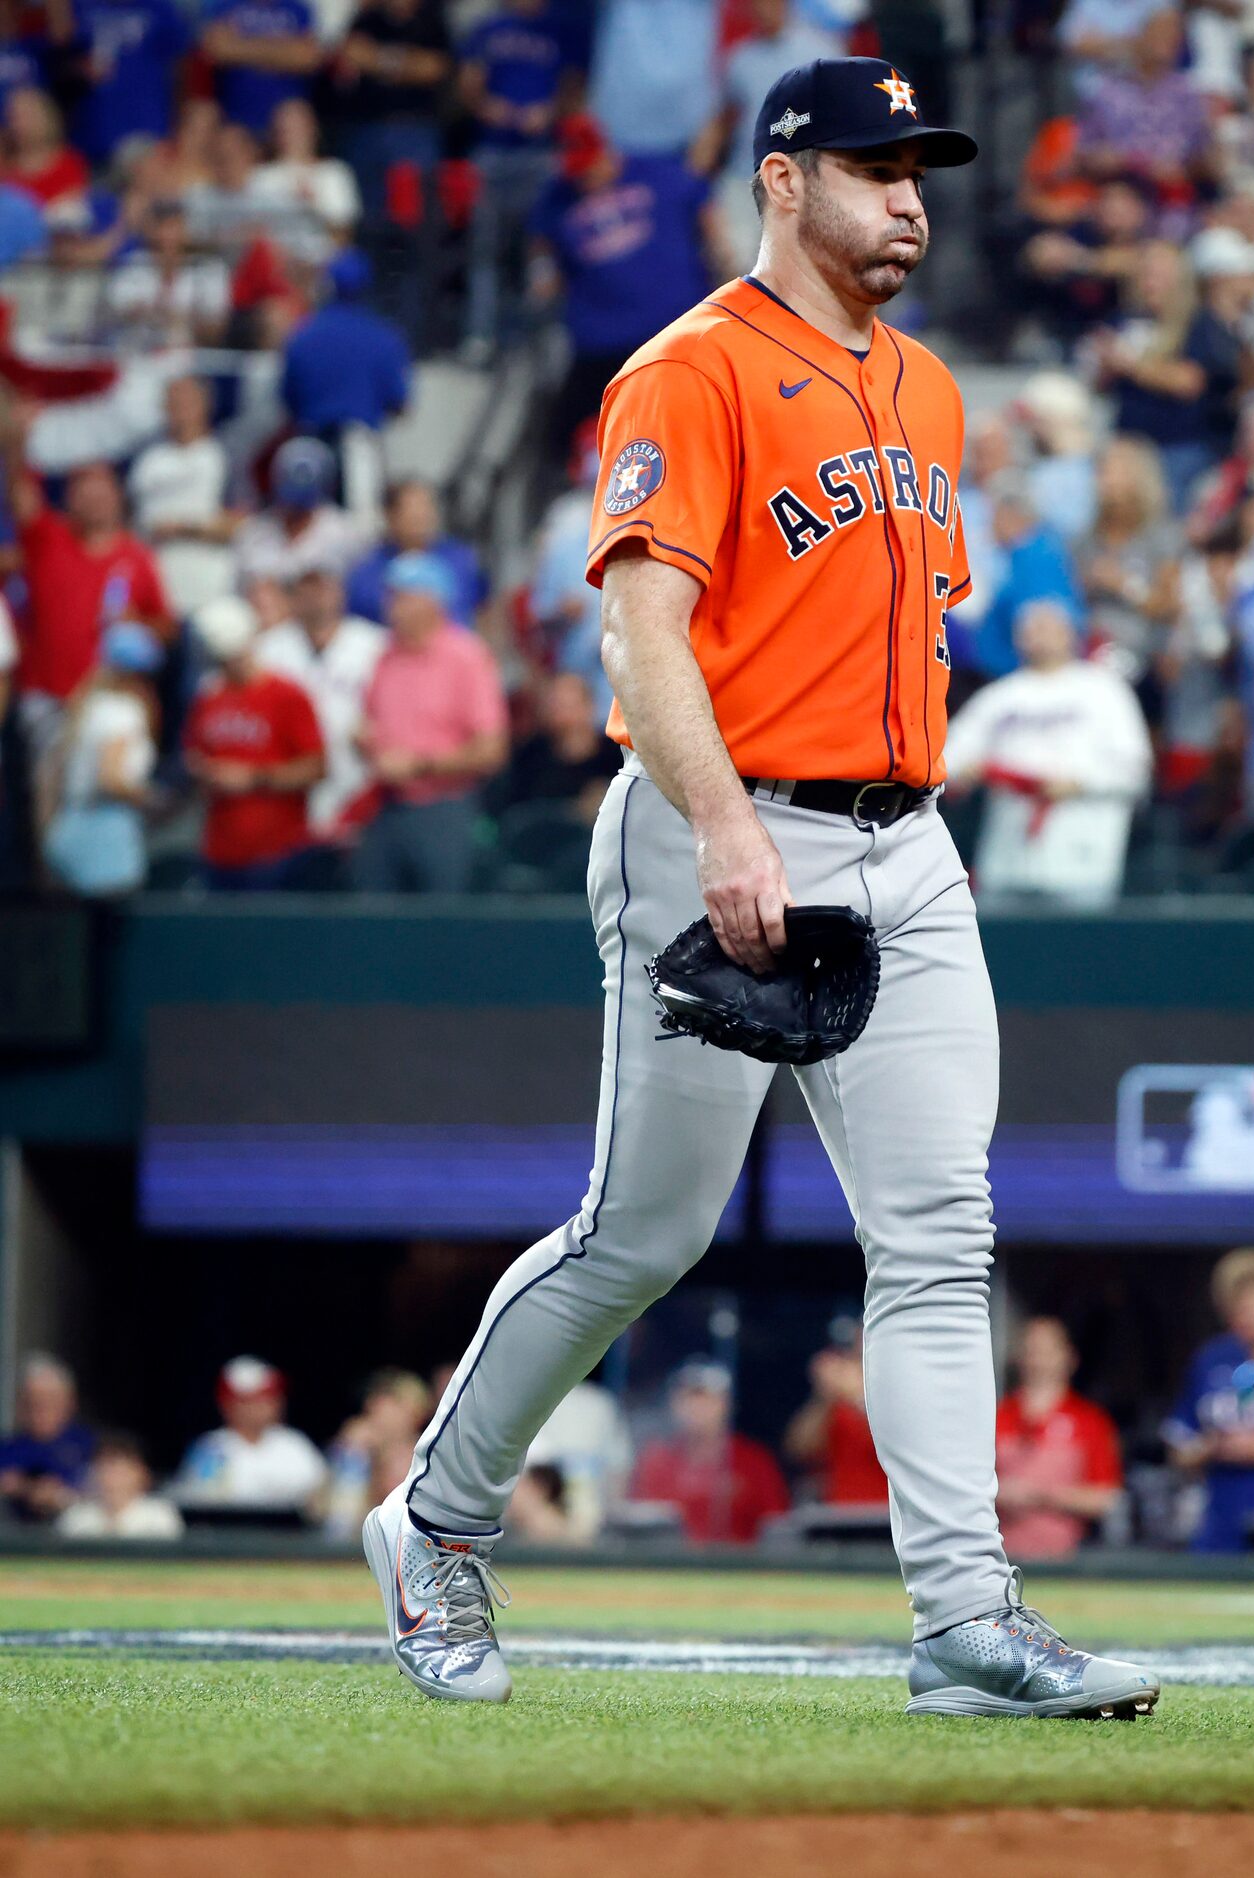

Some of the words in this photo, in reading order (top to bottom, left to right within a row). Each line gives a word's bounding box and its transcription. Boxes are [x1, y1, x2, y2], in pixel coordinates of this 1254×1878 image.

[883, 78, 916, 112] H
[614, 443, 660, 472] HOUSTON
[617, 463, 643, 494] H
[607, 489, 647, 511] ASTROS
[767, 446, 962, 560] ASTRO
